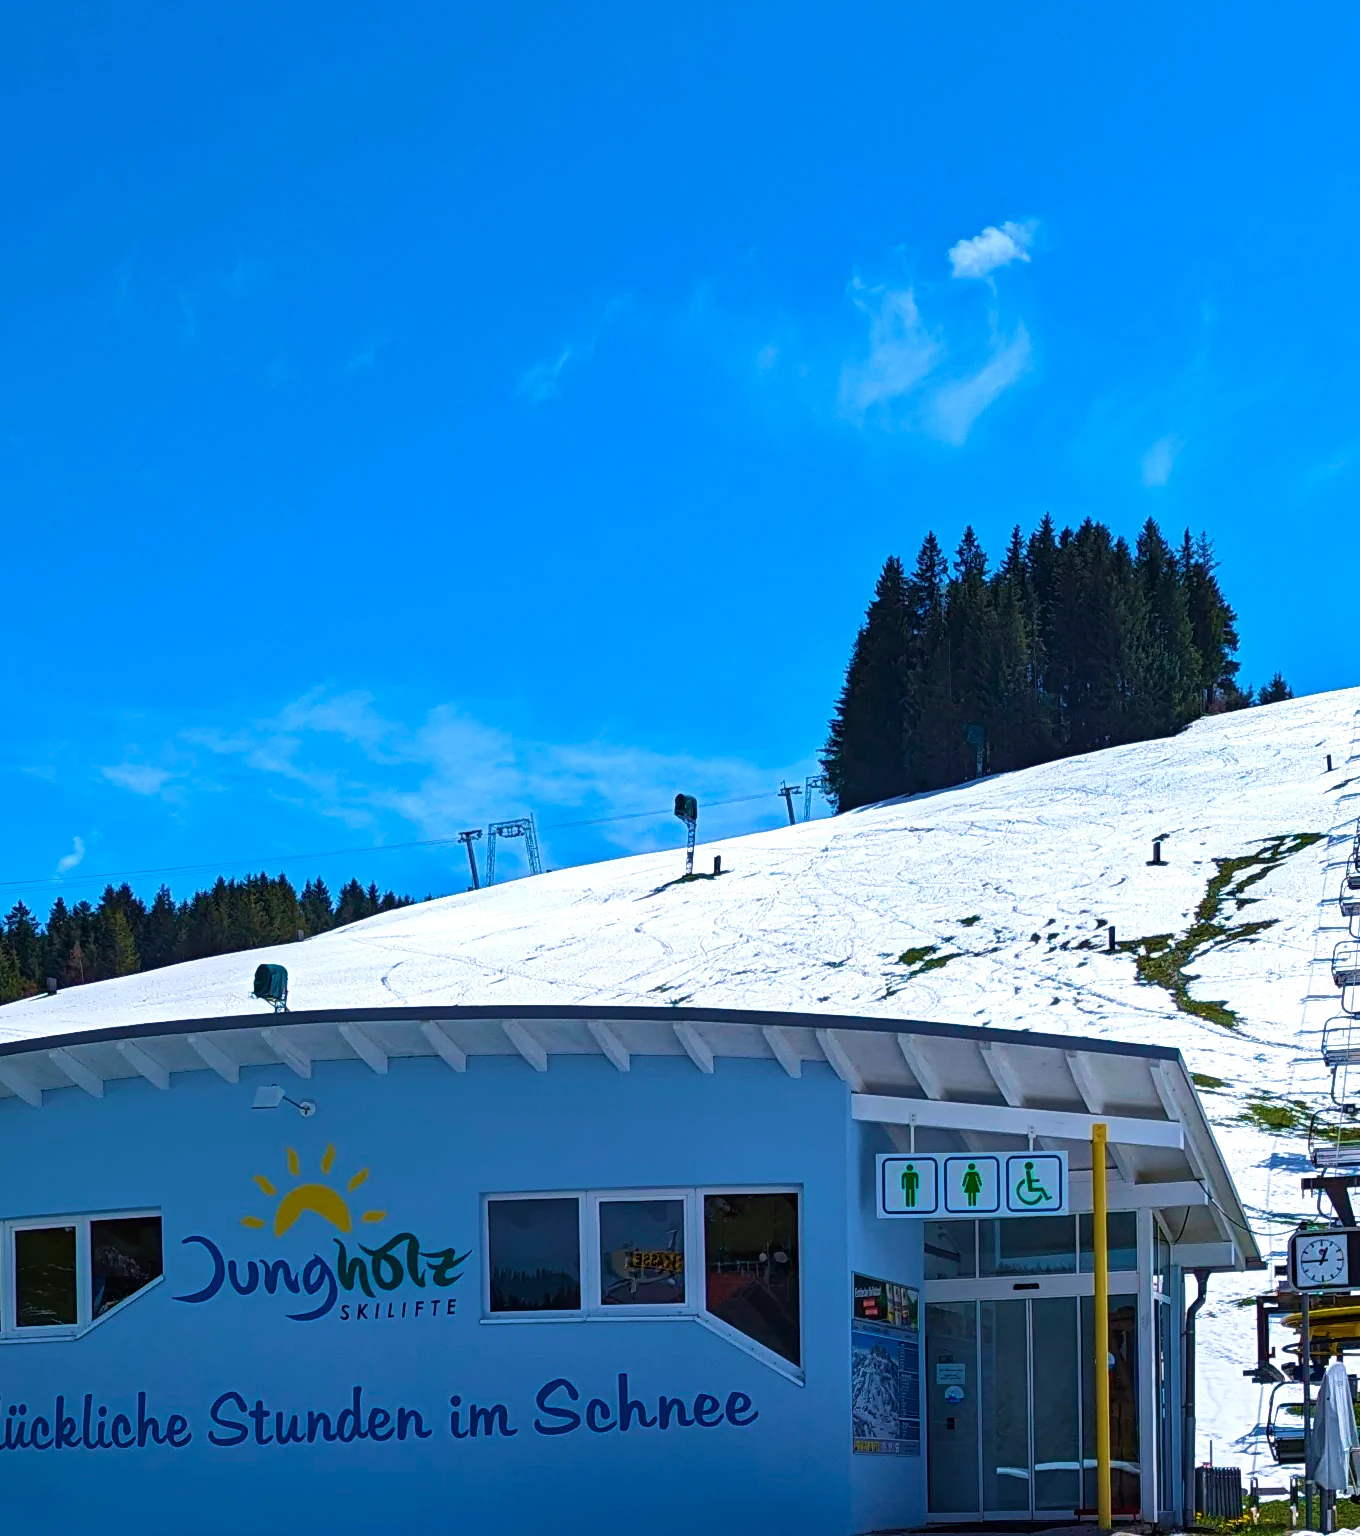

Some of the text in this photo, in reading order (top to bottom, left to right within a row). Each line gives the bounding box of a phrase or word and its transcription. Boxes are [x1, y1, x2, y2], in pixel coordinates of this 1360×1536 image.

[172, 1232, 473, 1321] Jungholz
[340, 1298, 457, 1321] SKILIFTE
[208, 1386, 432, 1446] Stunden
[449, 1395, 518, 1439] im
[534, 1373, 759, 1436] Schnee
